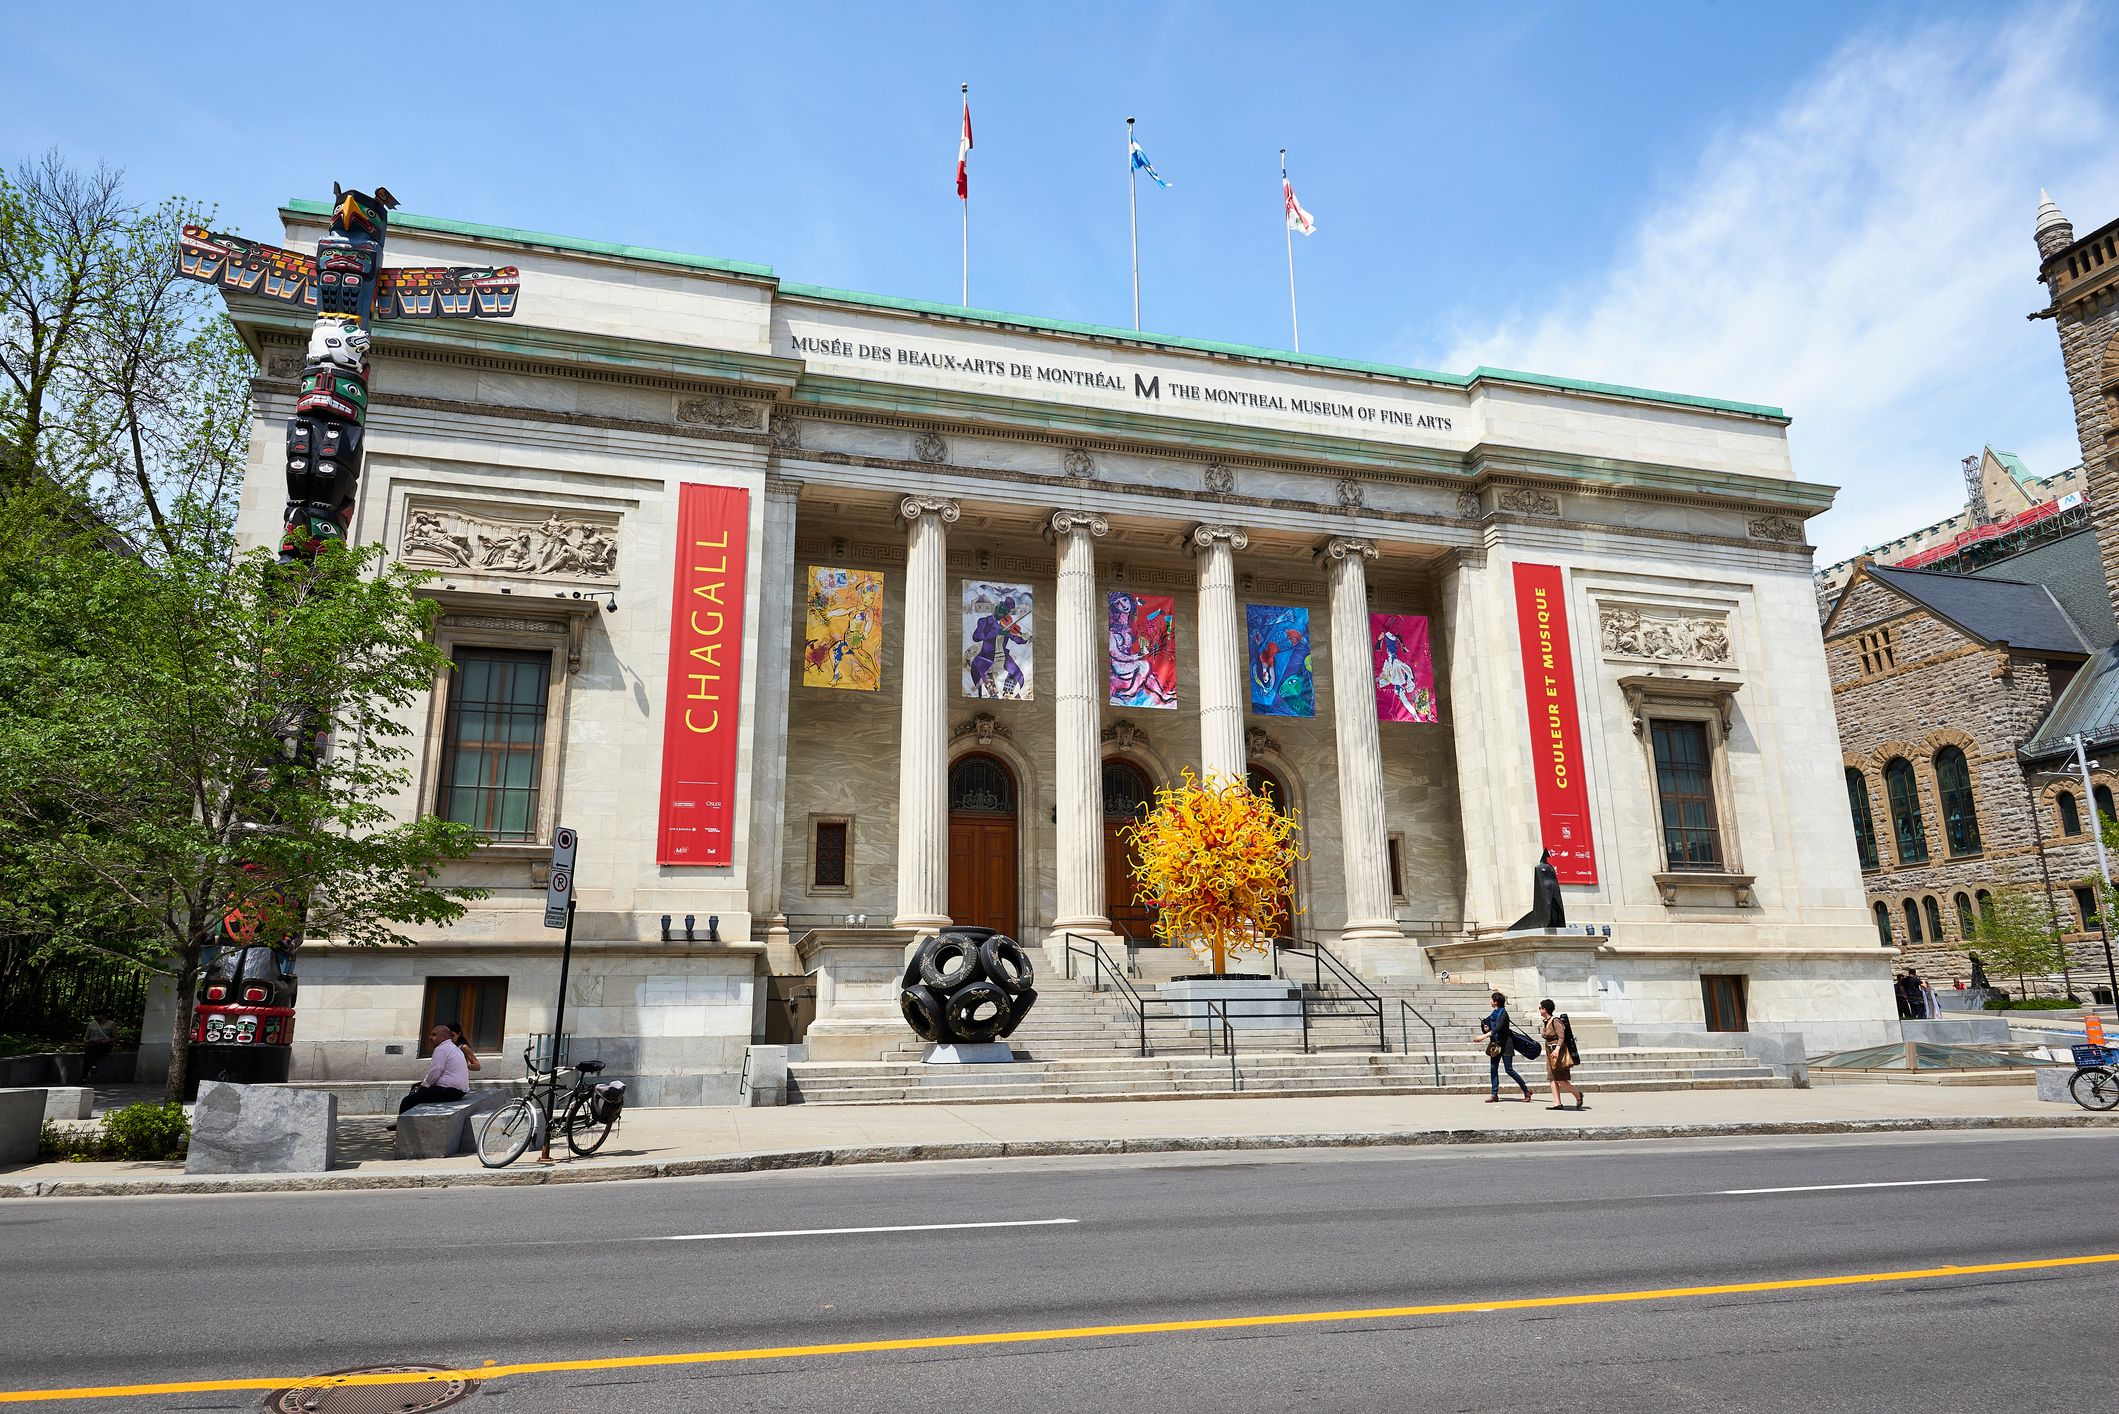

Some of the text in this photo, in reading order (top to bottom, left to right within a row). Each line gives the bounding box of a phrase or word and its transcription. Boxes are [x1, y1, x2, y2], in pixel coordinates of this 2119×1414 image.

[791, 336, 1126, 391] MUSÉE DES BEAUX-ARTS DE MONTRÉAL
[1134, 373, 1160, 399] M
[1168, 383, 1452, 431] THE MONTREAL MUSEUM OF FINE ARTS
[685, 530, 728, 734] CHAGALL
[1535, 587, 1568, 789] COULEUR ET MUSIQUE
